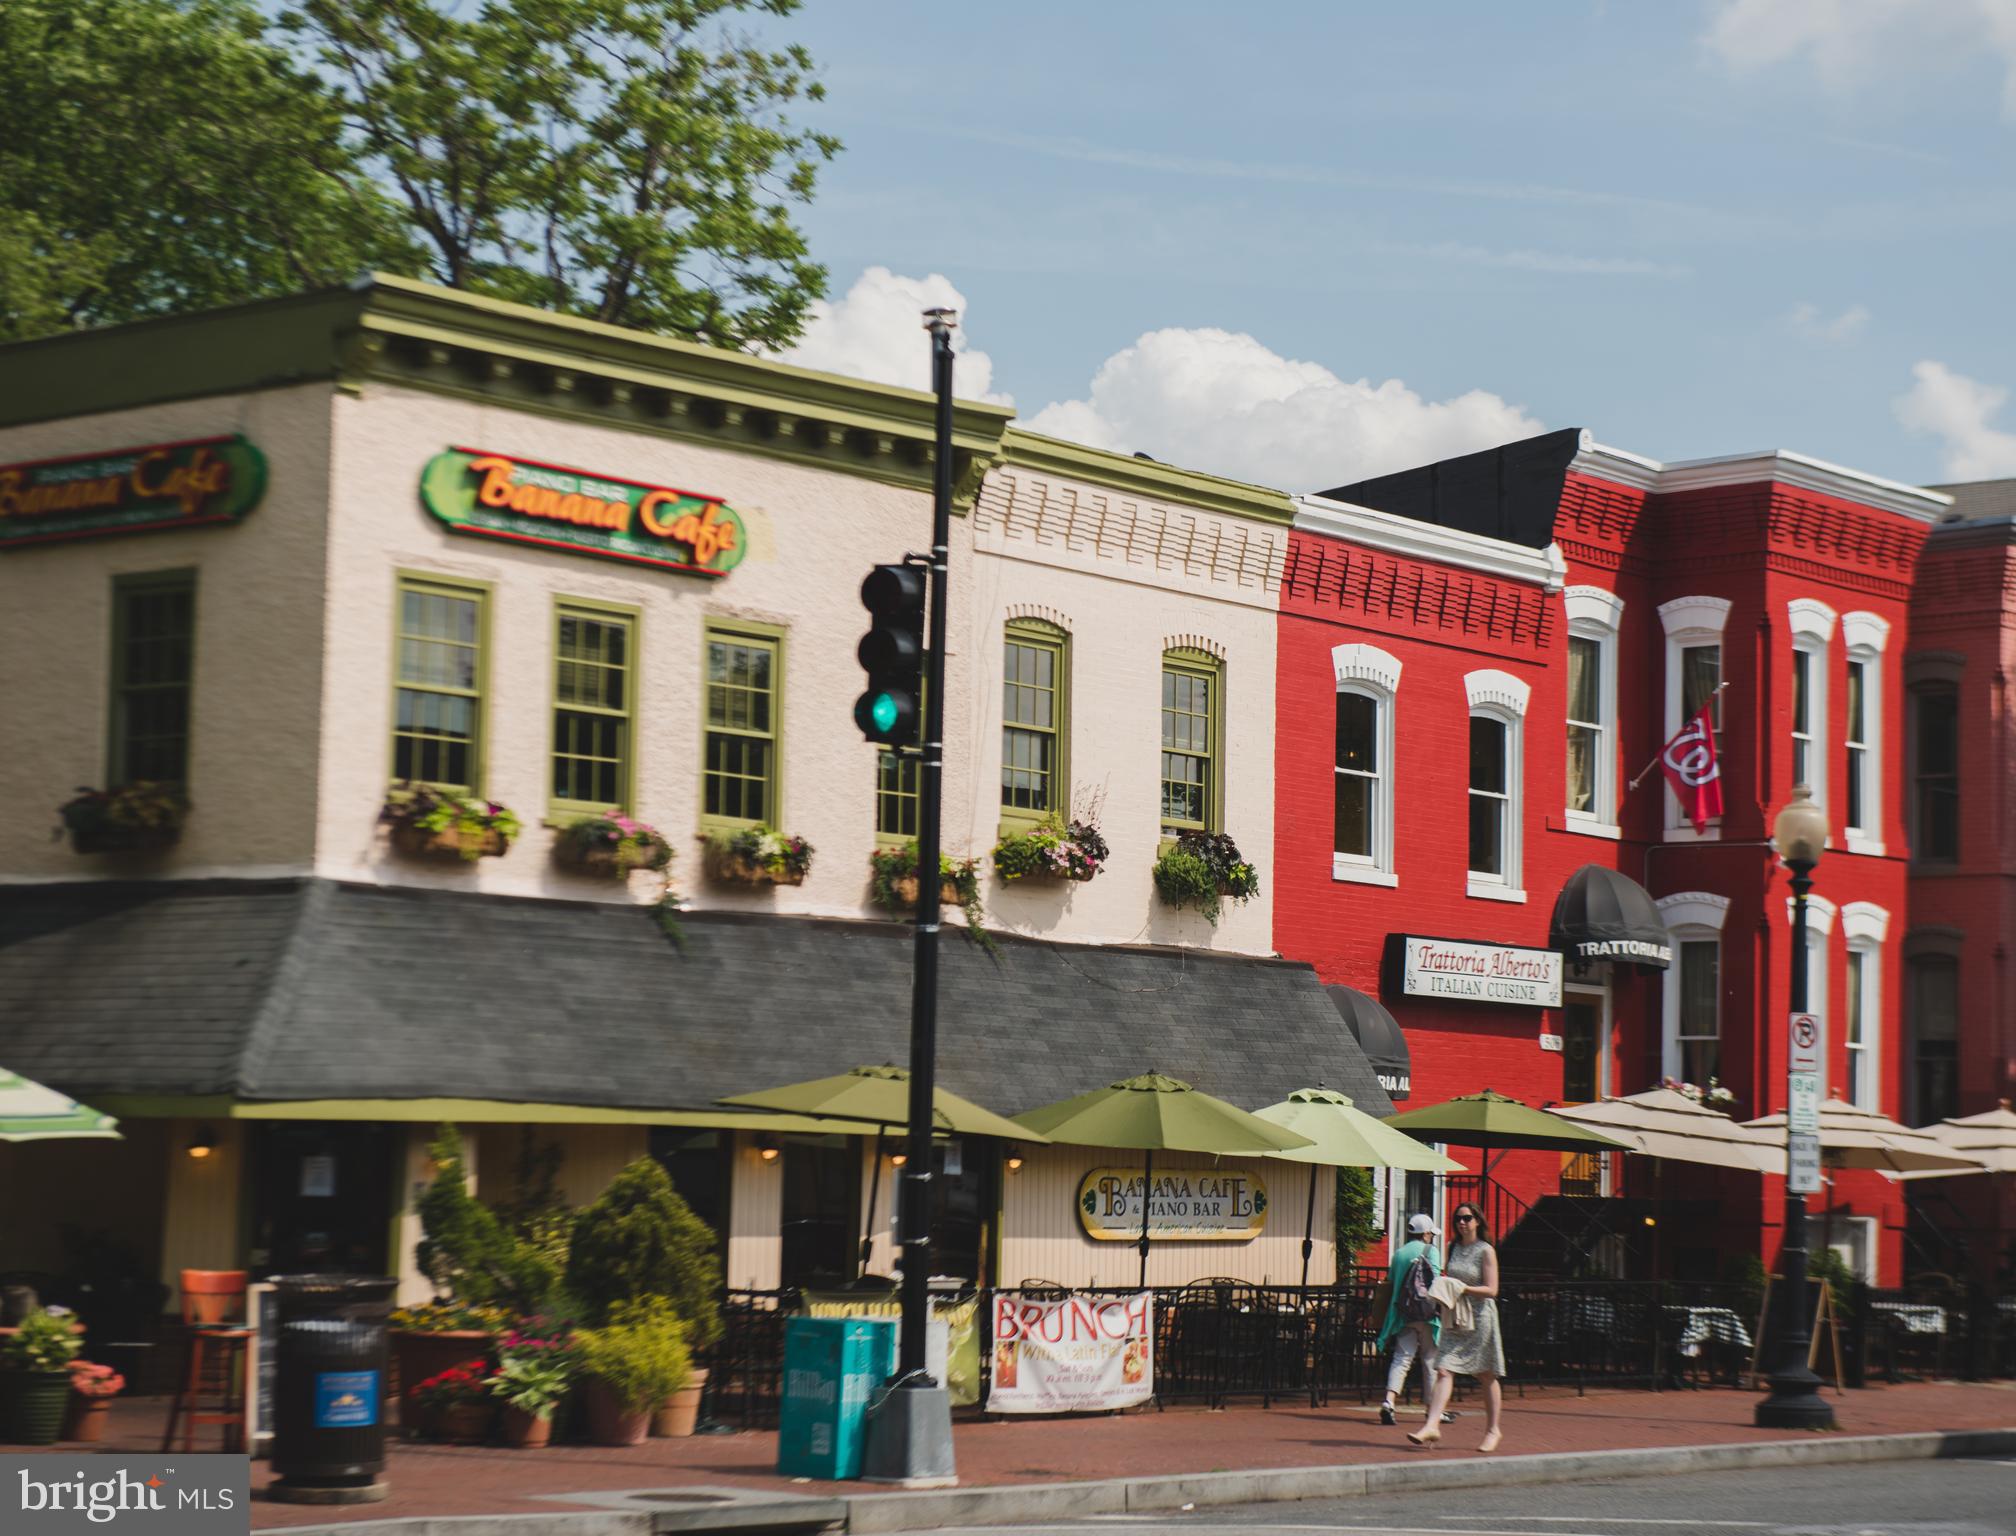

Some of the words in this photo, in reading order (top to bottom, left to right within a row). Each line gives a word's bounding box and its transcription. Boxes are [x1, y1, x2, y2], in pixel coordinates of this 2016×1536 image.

[468, 456, 632, 533] Banana
[579, 478, 630, 503] BAR
[1418, 944, 1486, 973] Trattoria
[1486, 950, 1550, 980] Alberto's
[1431, 976, 1483, 996] ITALIAN
[1487, 982, 1537, 1001] CUISINE
[1193, 1201, 1221, 1217] BAR
[996, 1295, 1149, 1343] BRUNCH
